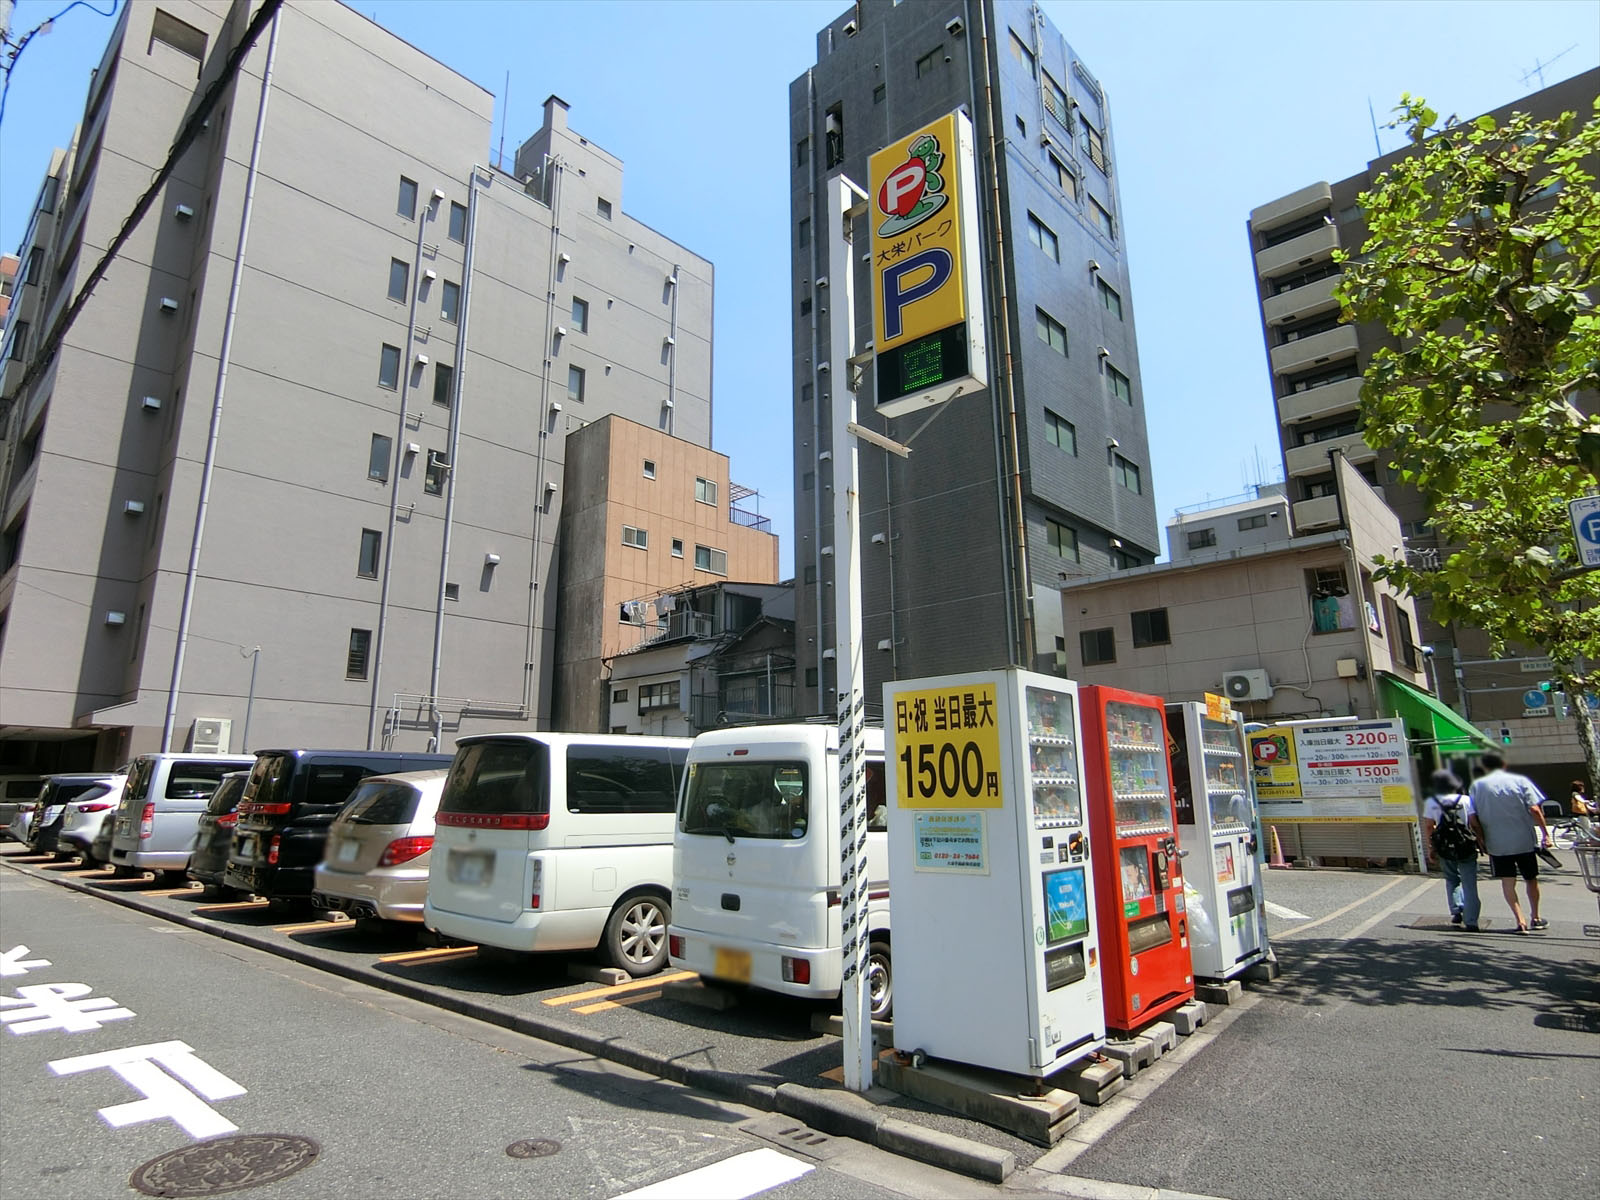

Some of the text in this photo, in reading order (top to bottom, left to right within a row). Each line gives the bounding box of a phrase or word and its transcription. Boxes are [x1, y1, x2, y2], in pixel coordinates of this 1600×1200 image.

[886, 166, 924, 212] P
[876, 219, 953, 267] 大栄パーク
[881, 247, 954, 341] P
[1259, 743, 1276, 758] P
[1345, 731, 1398, 746] 3200円
[900, 741, 999, 799] 1500円
[1356, 766, 1399, 777] 1500円
